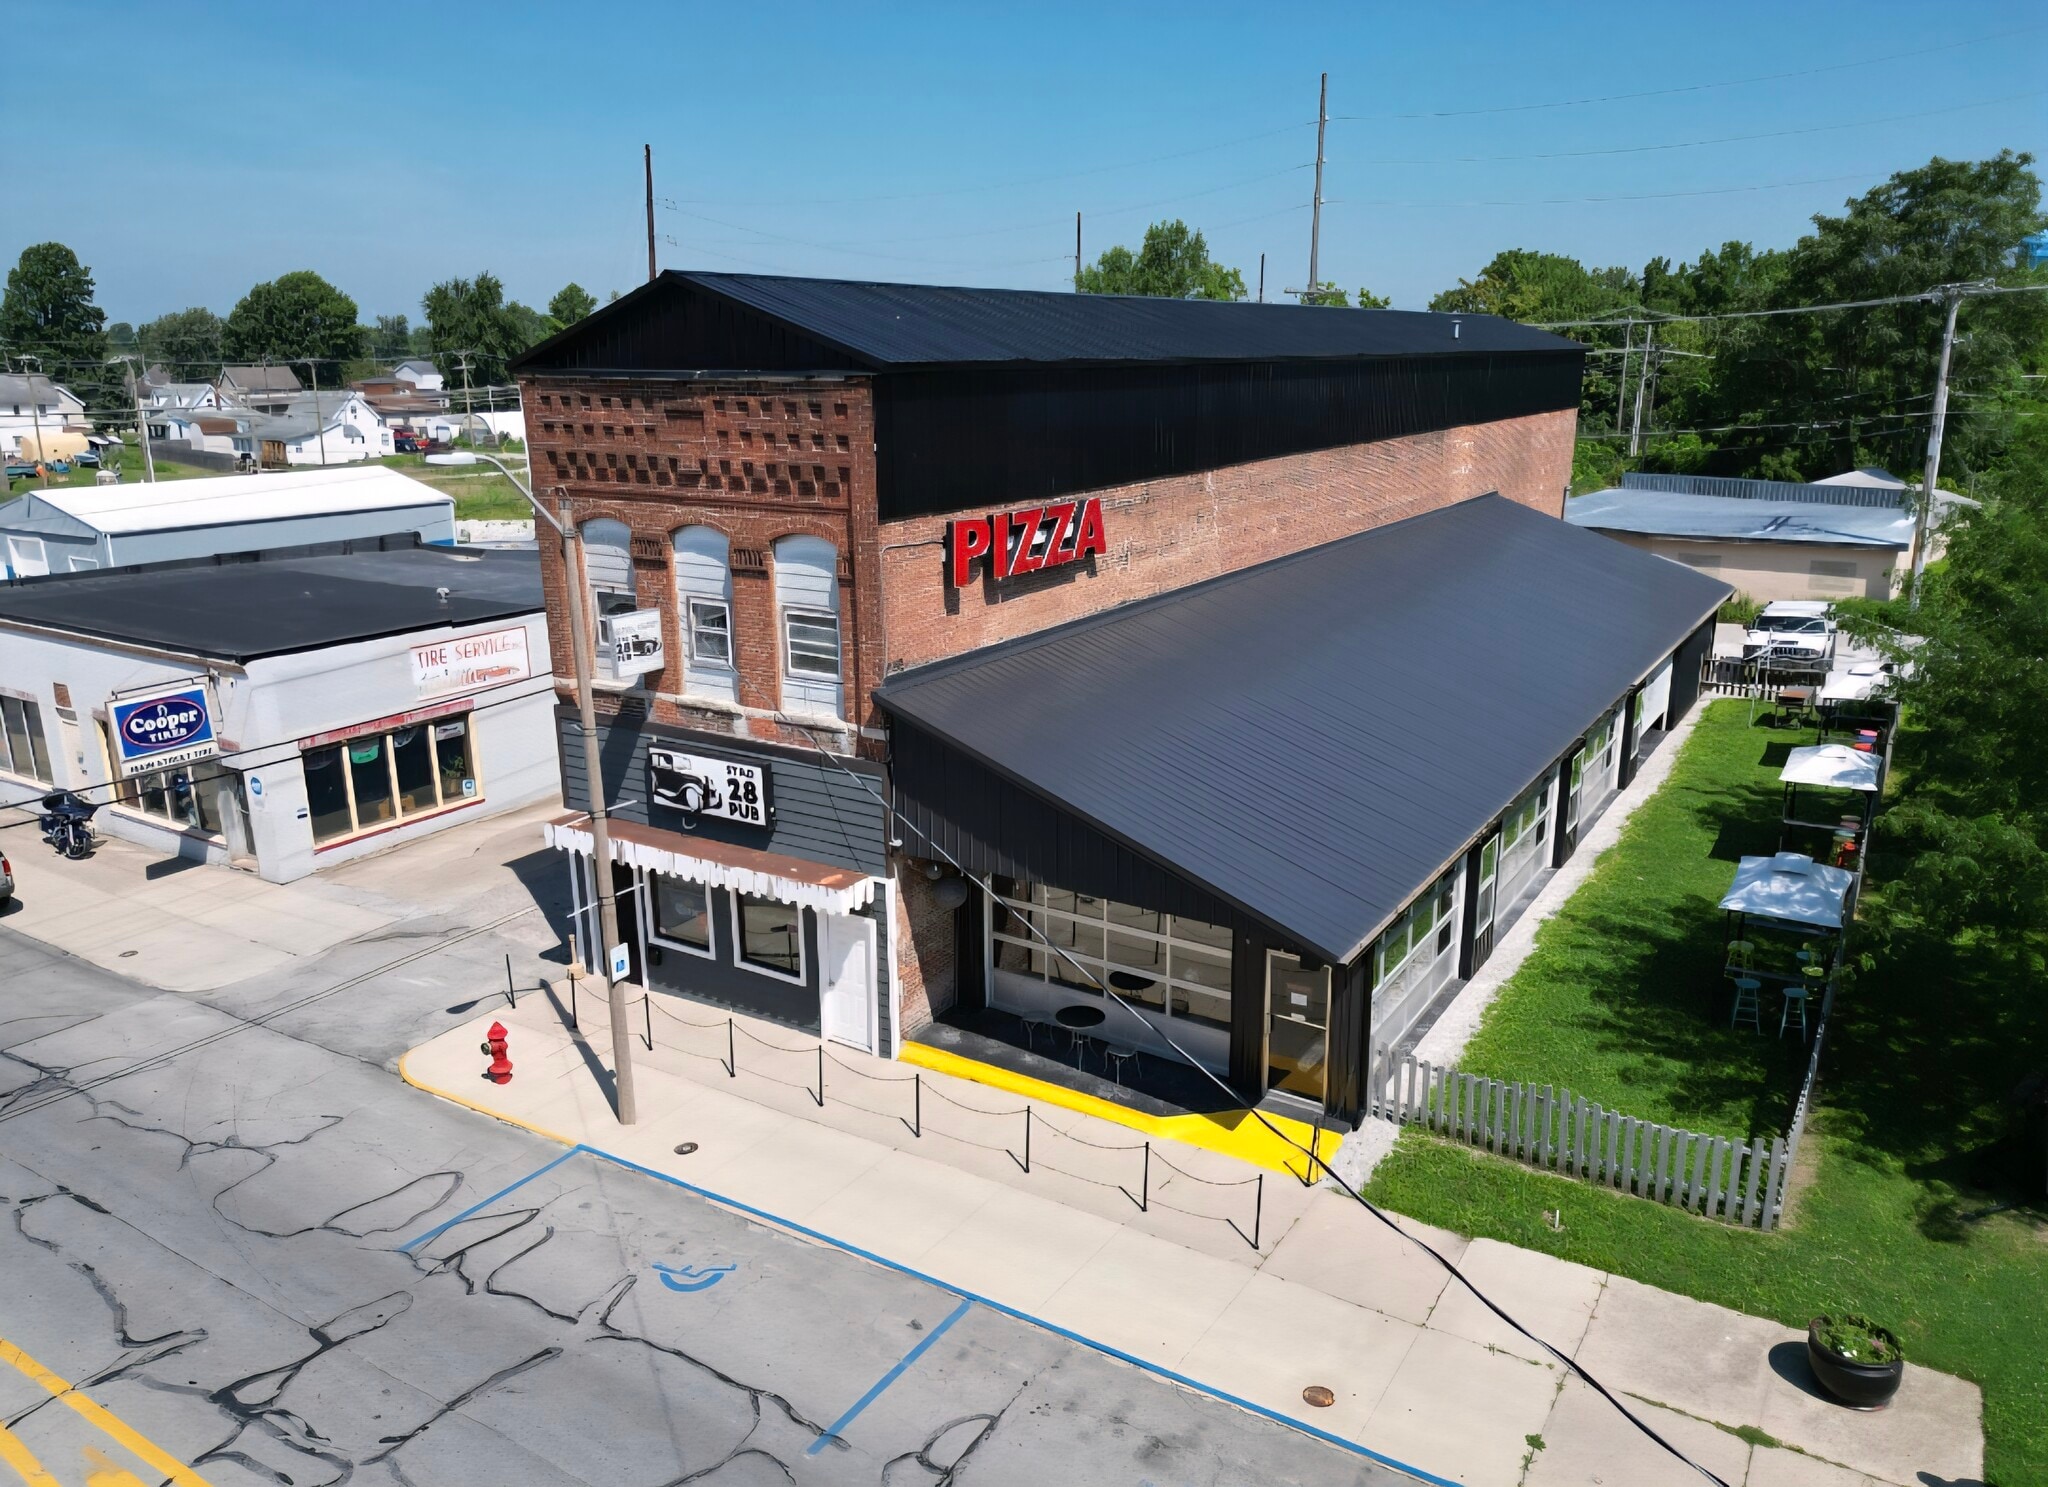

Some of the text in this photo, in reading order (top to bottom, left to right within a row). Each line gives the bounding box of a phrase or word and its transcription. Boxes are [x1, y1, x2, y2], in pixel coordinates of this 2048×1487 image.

[950, 497, 1107, 589] PIZZA
[418, 648, 448, 668] TIRE
[130, 708, 198, 734] Cooper
[727, 778, 759, 804] 28
[728, 802, 759, 821] PUB
